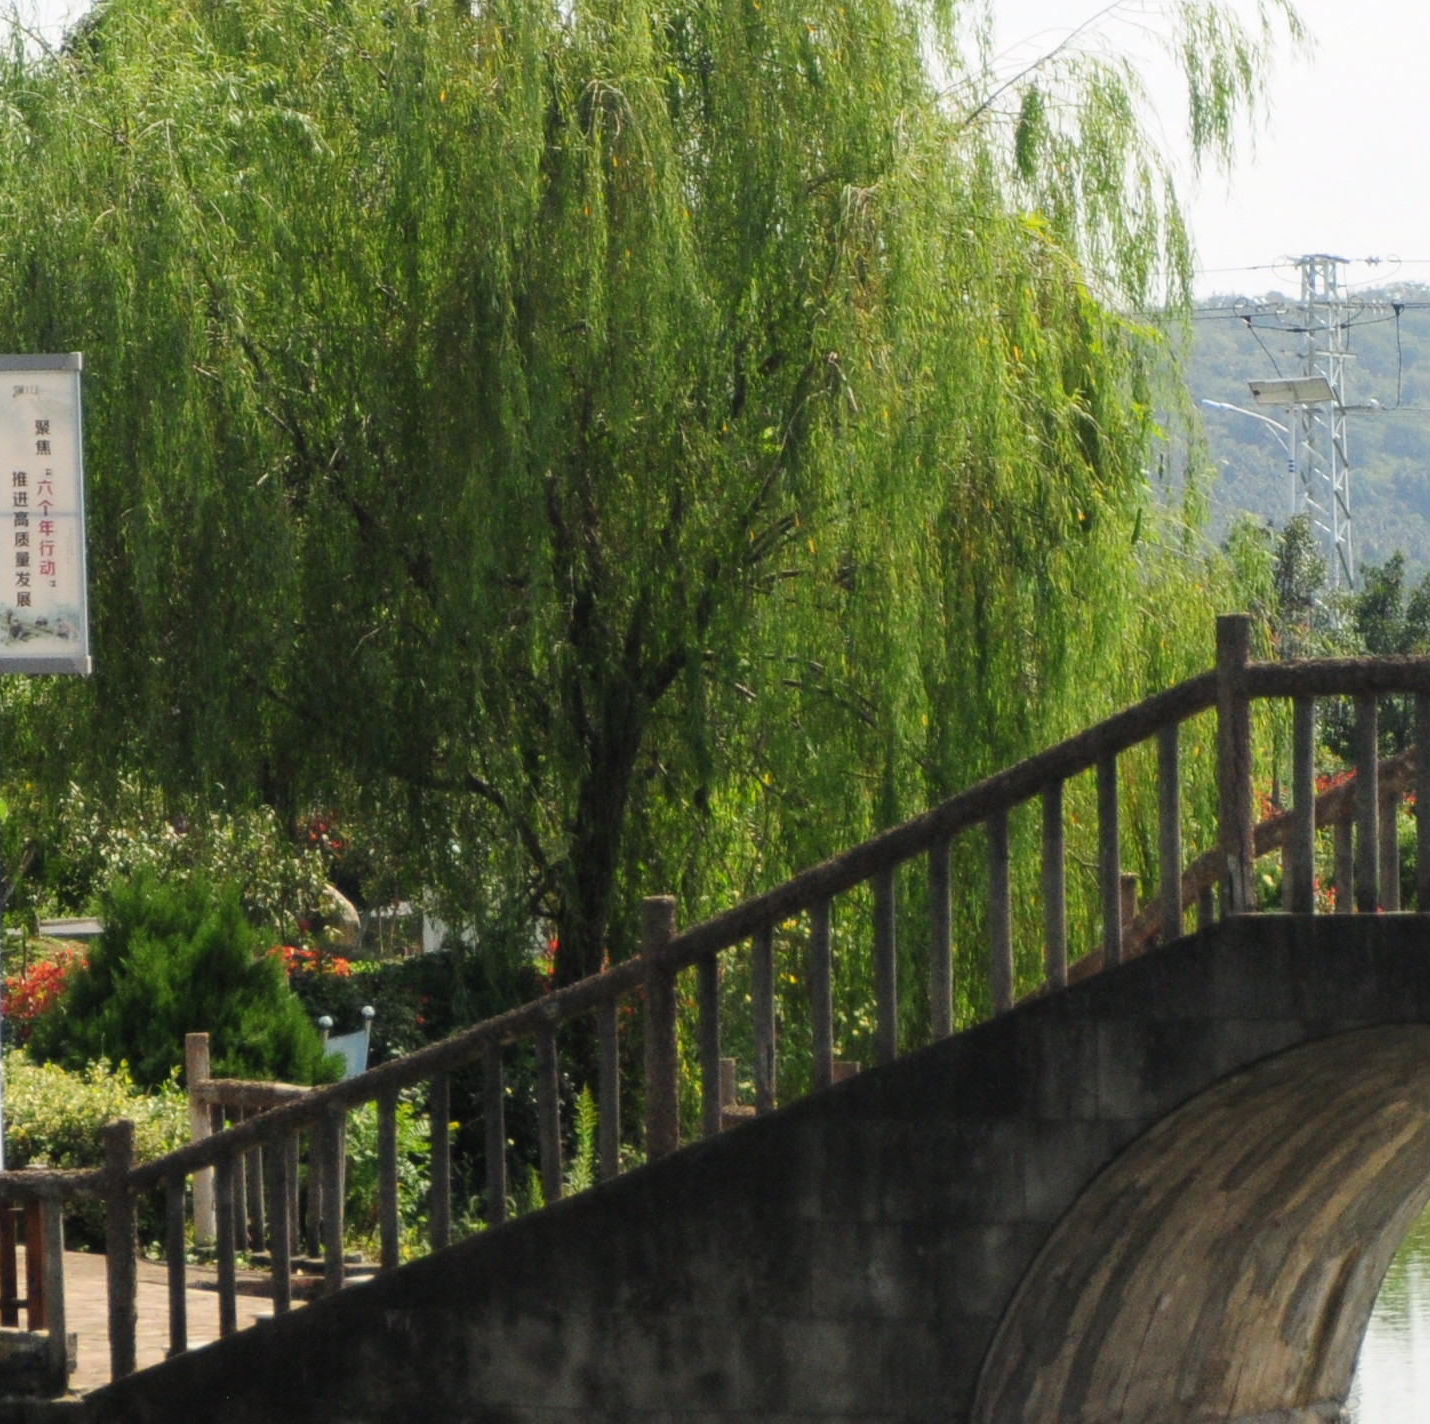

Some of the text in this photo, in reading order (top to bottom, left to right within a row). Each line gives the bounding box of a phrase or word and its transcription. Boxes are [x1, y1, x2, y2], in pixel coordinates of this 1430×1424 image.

[12, 470, 32, 608] 推进高质量发展
